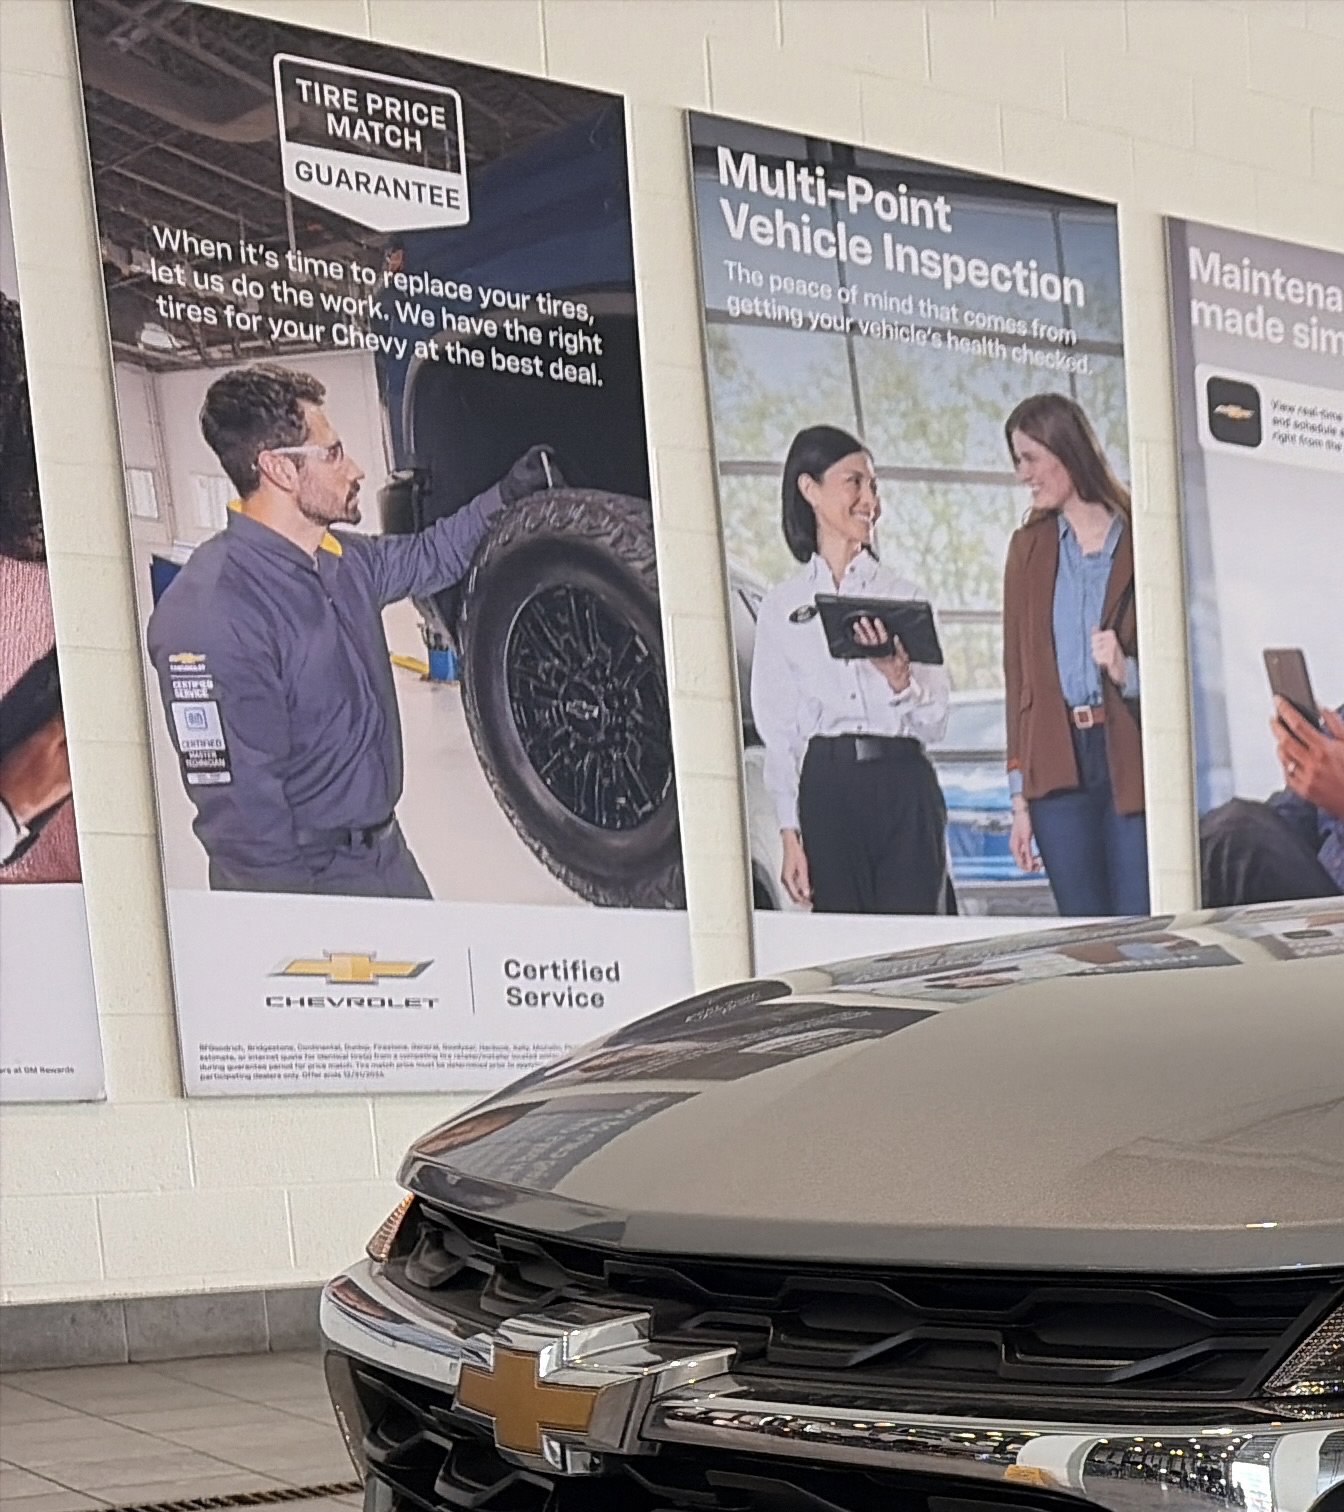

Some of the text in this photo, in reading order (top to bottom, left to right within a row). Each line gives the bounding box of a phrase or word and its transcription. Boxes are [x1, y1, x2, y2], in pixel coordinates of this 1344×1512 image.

[296, 78, 446, 130] TIRE PRICE
[327, 113, 421, 152] MATCH
[295, 160, 460, 210] GUARANTEE
[716, 145, 953, 233] Multi-Point
[152, 225, 594, 326] When it's time to replace your tires,
[719, 197, 1086, 307] Vehicle Inspection
[150, 257, 603, 356] let us do the work. We have the right
[724, 260, 1077, 346] The peace of mind that comes from
[727, 295, 1093, 375] getting your vehicle's health checked.
[1190, 298, 1285, 344] made
[156, 295, 603, 387] tires for your Chevy at the best deal.
[265, 996, 439, 1009] CHEVROLET
[504, 958, 621, 982] Certified
[506, 986, 605, 1008] Service
